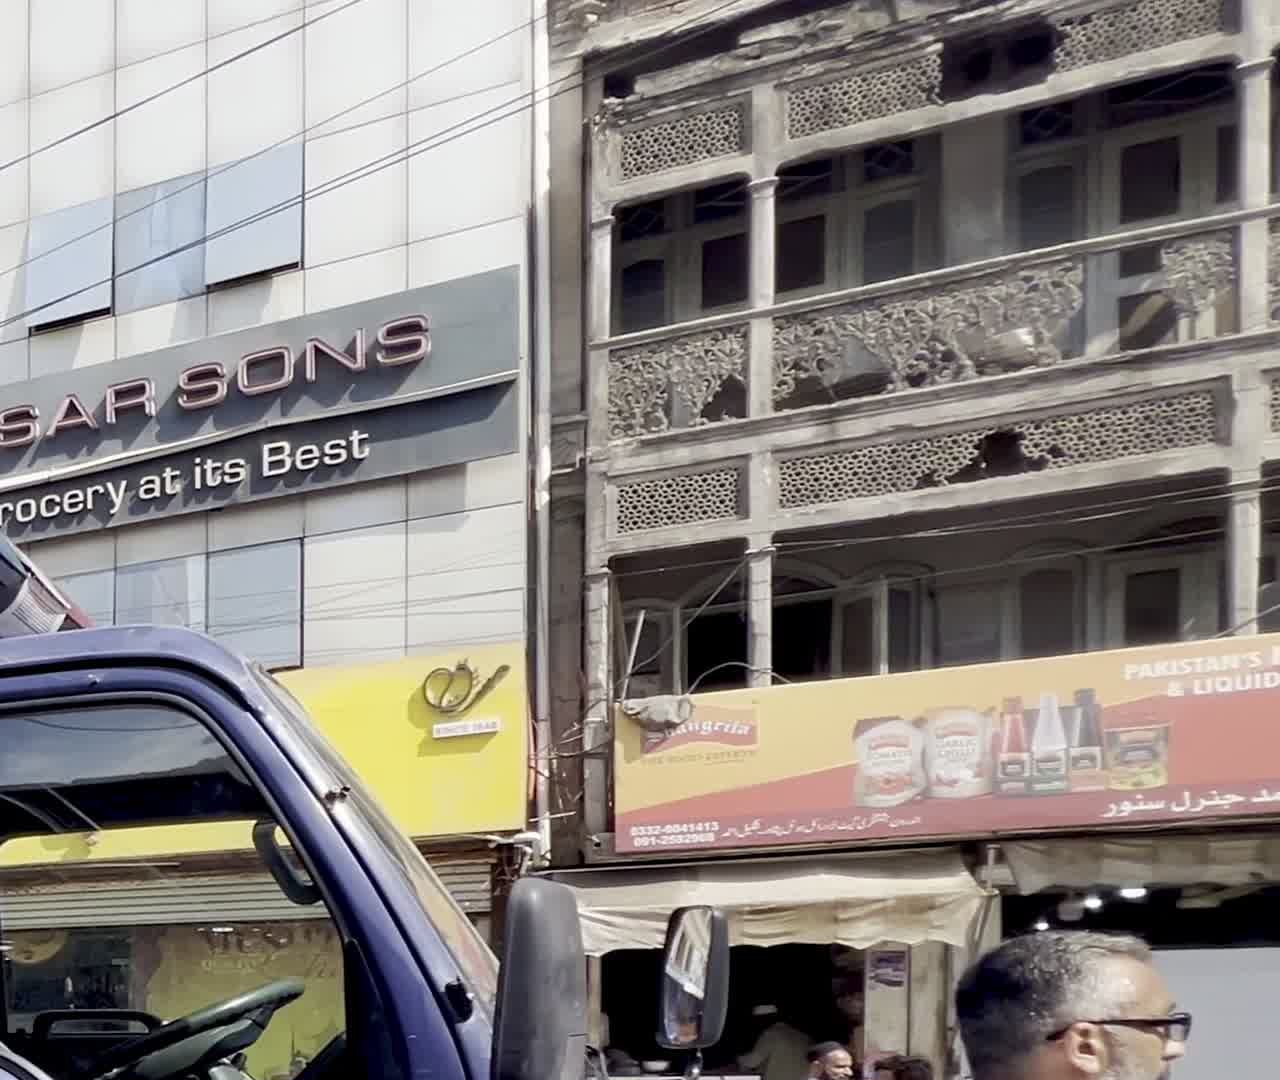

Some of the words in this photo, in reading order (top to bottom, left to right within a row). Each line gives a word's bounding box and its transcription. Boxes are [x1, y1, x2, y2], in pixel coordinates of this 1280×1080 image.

[176, 313, 433, 411] SONS
[139, 464, 181, 501] at
[193, 457, 246, 491] its
[262, 430, 372, 478] Best
[1124, 651, 1263, 681] PAKISTAN'S
[1193, 671, 1280, 696] LIQUID
